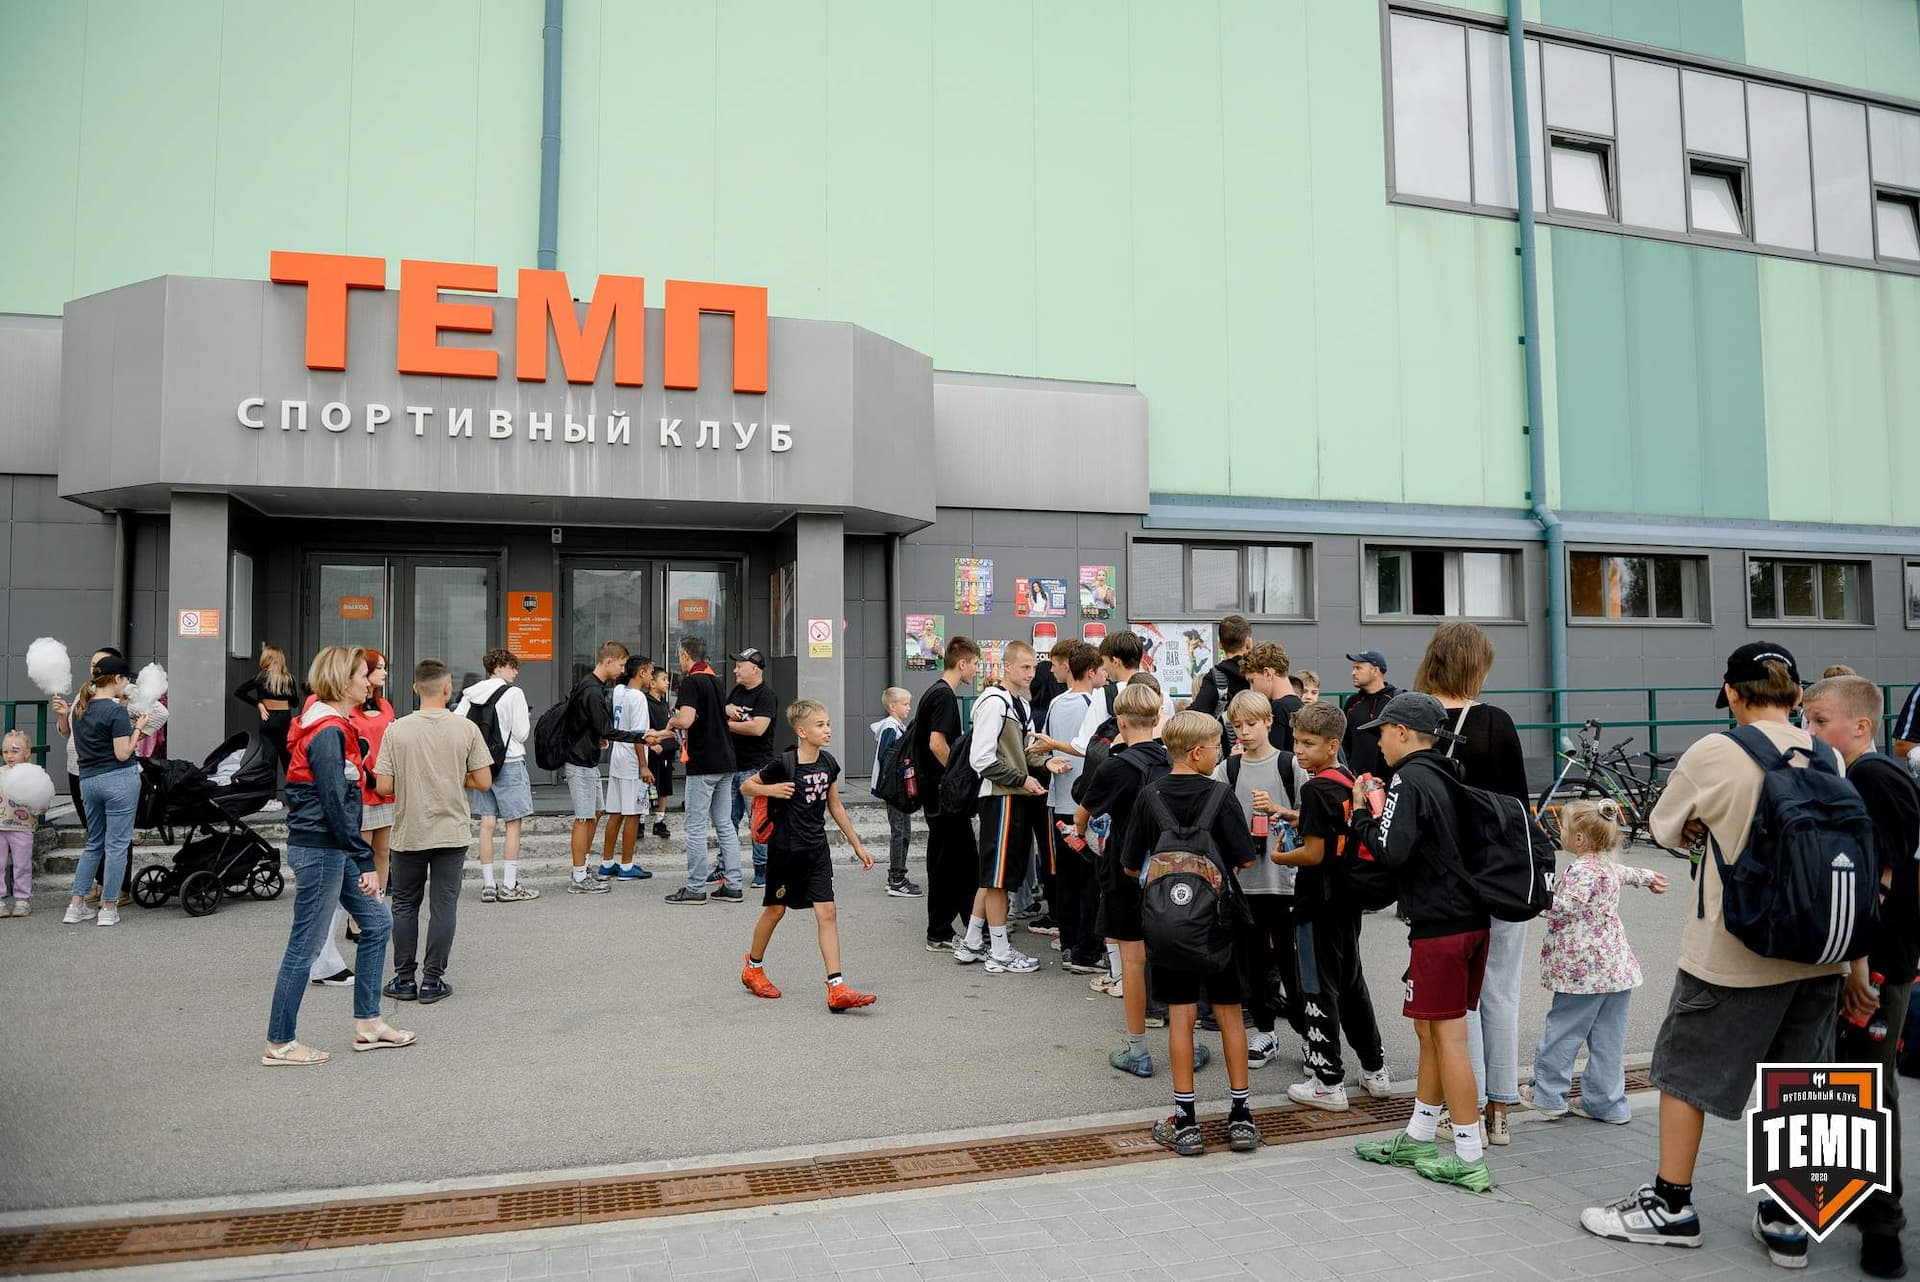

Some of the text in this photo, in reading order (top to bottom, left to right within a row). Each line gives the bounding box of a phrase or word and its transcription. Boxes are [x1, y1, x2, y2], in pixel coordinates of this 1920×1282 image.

[270, 250, 768, 395] ТЕМП
[236, 397, 794, 453] СПОРТИВНЫЙ КЛУБ
[1166, 651, 1180, 666] BAR
